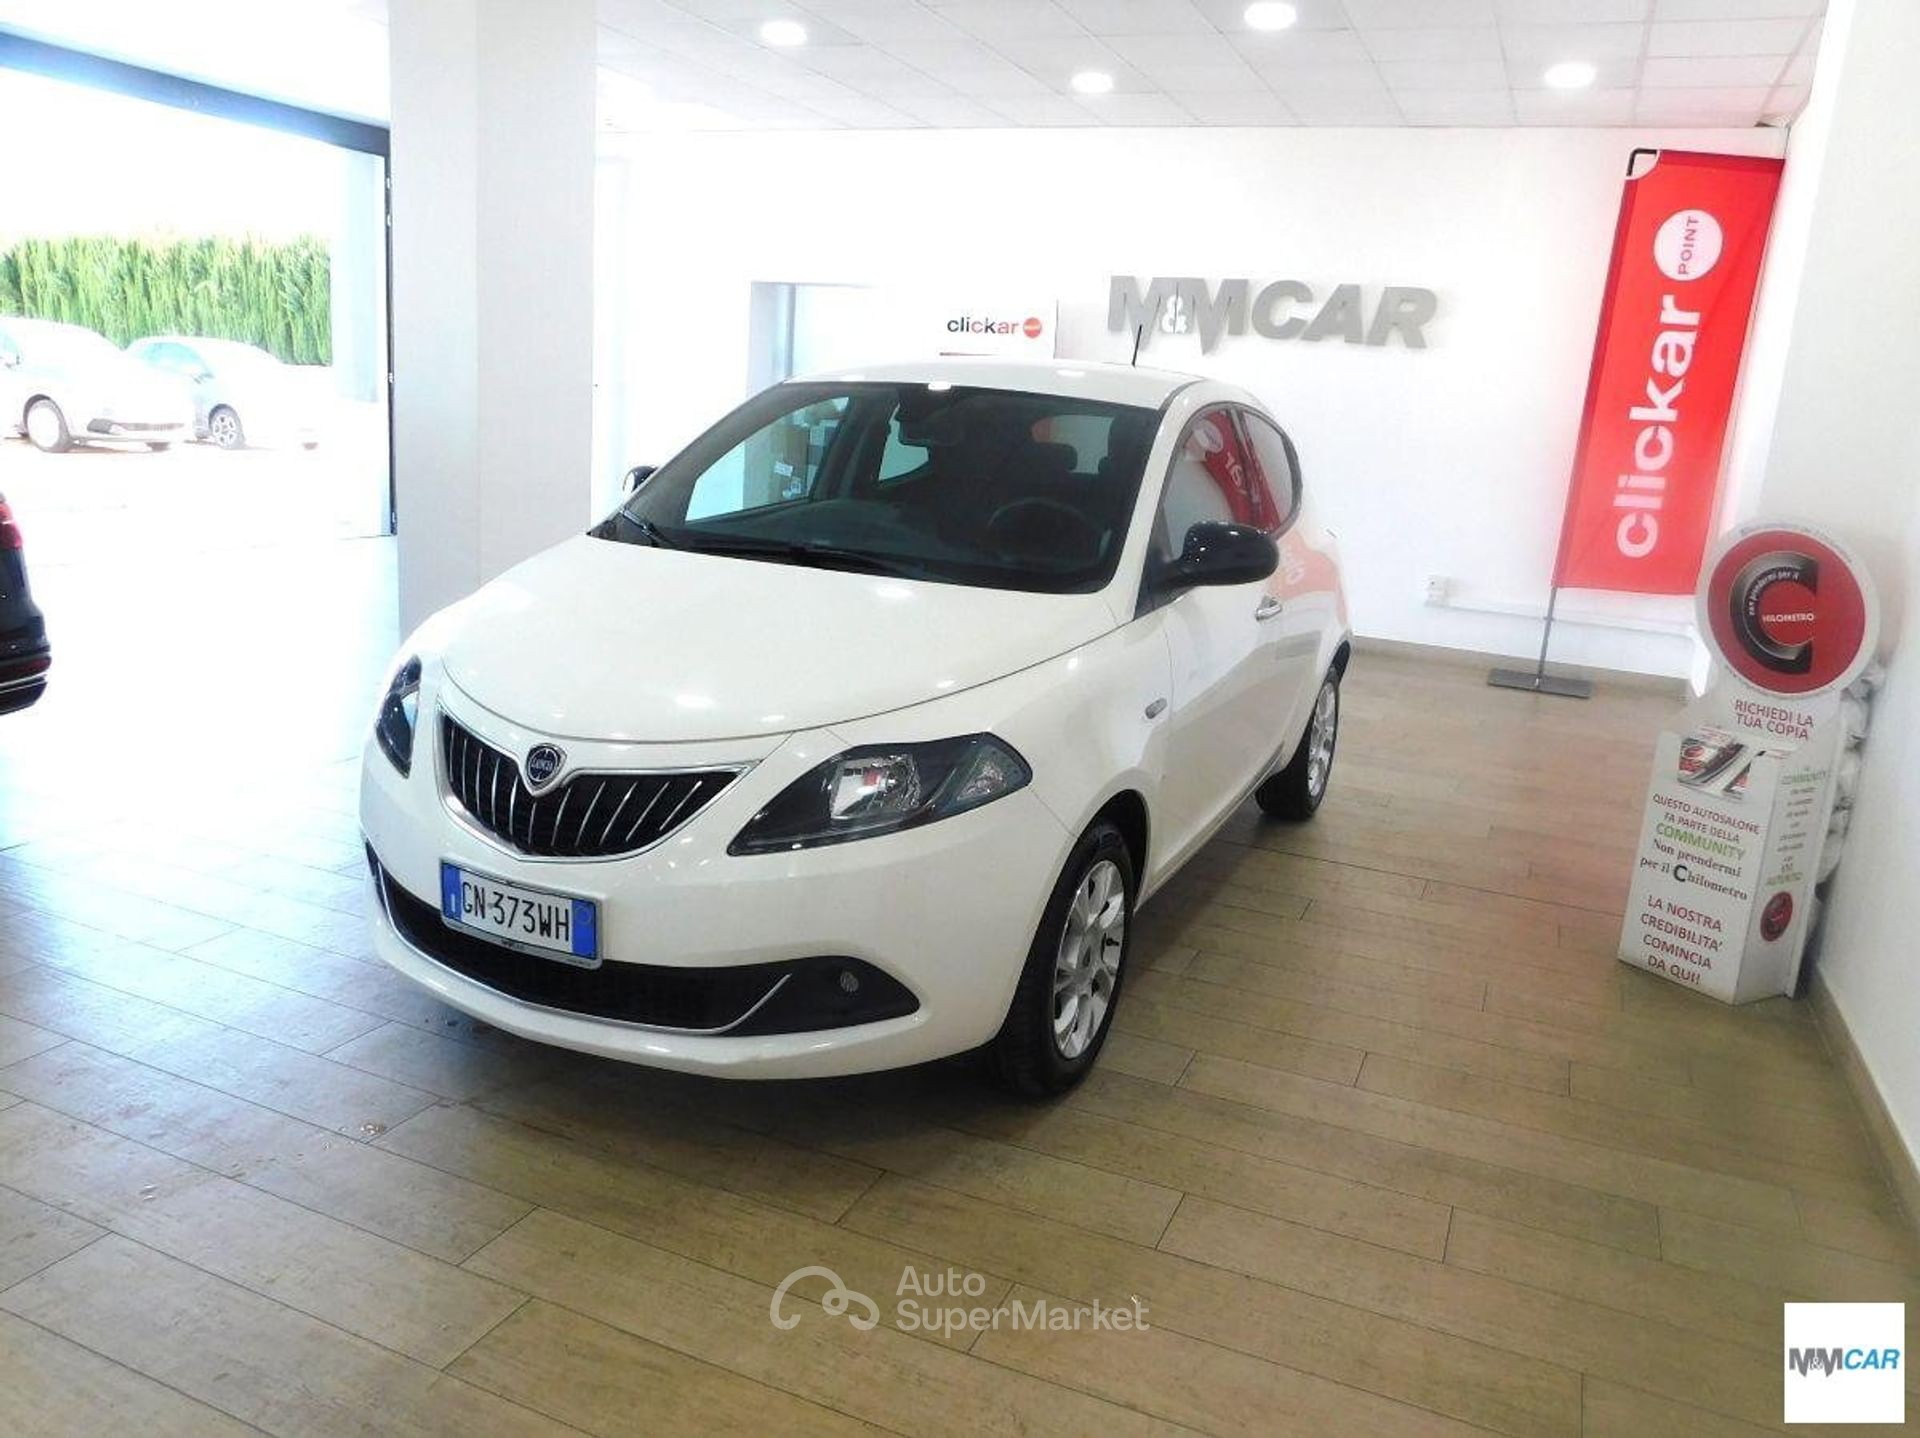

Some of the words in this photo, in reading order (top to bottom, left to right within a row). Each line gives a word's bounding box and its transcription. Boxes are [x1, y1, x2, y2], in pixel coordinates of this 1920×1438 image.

[1677, 215, 1699, 276] POINT
[946, 317, 1020, 334] clickar
[1613, 294, 1700, 559] clickar
[1734, 700, 1793, 723] RICHIEDI
[1796, 713, 1814, 728] LA
[1736, 713, 1763, 729] TUA
[1766, 720, 1809, 740] COPIA
[1652, 793, 1691, 813] QUESTO
[1692, 807, 1760, 835] AUTOSALONE
[1677, 816, 1708, 833] PARTE
[1710, 825, 1740, 844] DELLA
[1653, 838, 1675, 856] Non
[1677, 849, 1742, 878] prendermi
[1656, 822, 1746, 861] COMMUNITY
[1640, 857, 1659, 870] per
[1647, 895, 1663, 910] LA
[1667, 902, 1722, 932] NOSTRA
[1641, 913, 1723, 952] CREDIBILITA'
[1643, 934, 1712, 969] COMINCIA
[1647, 955, 1666, 971] DA
